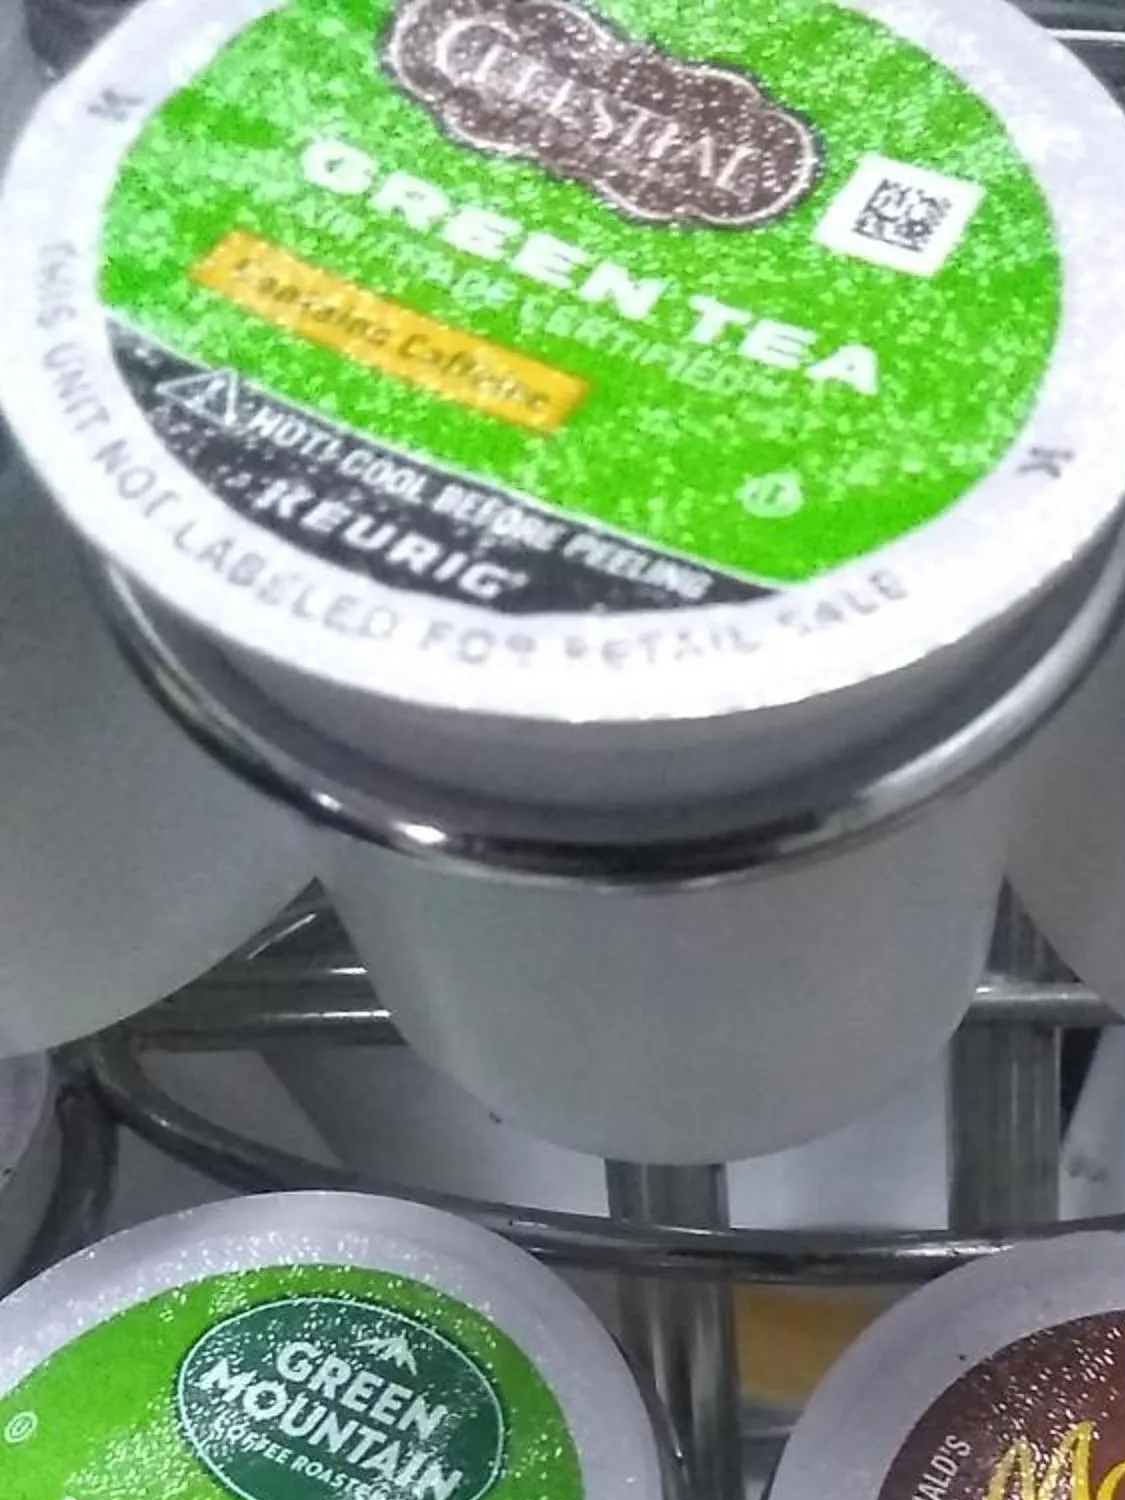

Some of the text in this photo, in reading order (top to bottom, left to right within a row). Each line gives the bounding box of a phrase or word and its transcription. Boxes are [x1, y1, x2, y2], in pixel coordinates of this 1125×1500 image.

[302, 138, 879, 396] GREEN TEA
[93, 437, 180, 518] NOT
[173, 520, 398, 642] LABELED
[776, 567, 908, 637] SALE
[248, 405, 341, 464] HOT!
[340, 448, 425, 503] COOL
[433, 482, 567, 551] BEFORE
[252, 478, 506, 600] KEURIG
[213, 1415, 292, 1467] COFFEE
[275, 1339, 450, 1440] GREEN
